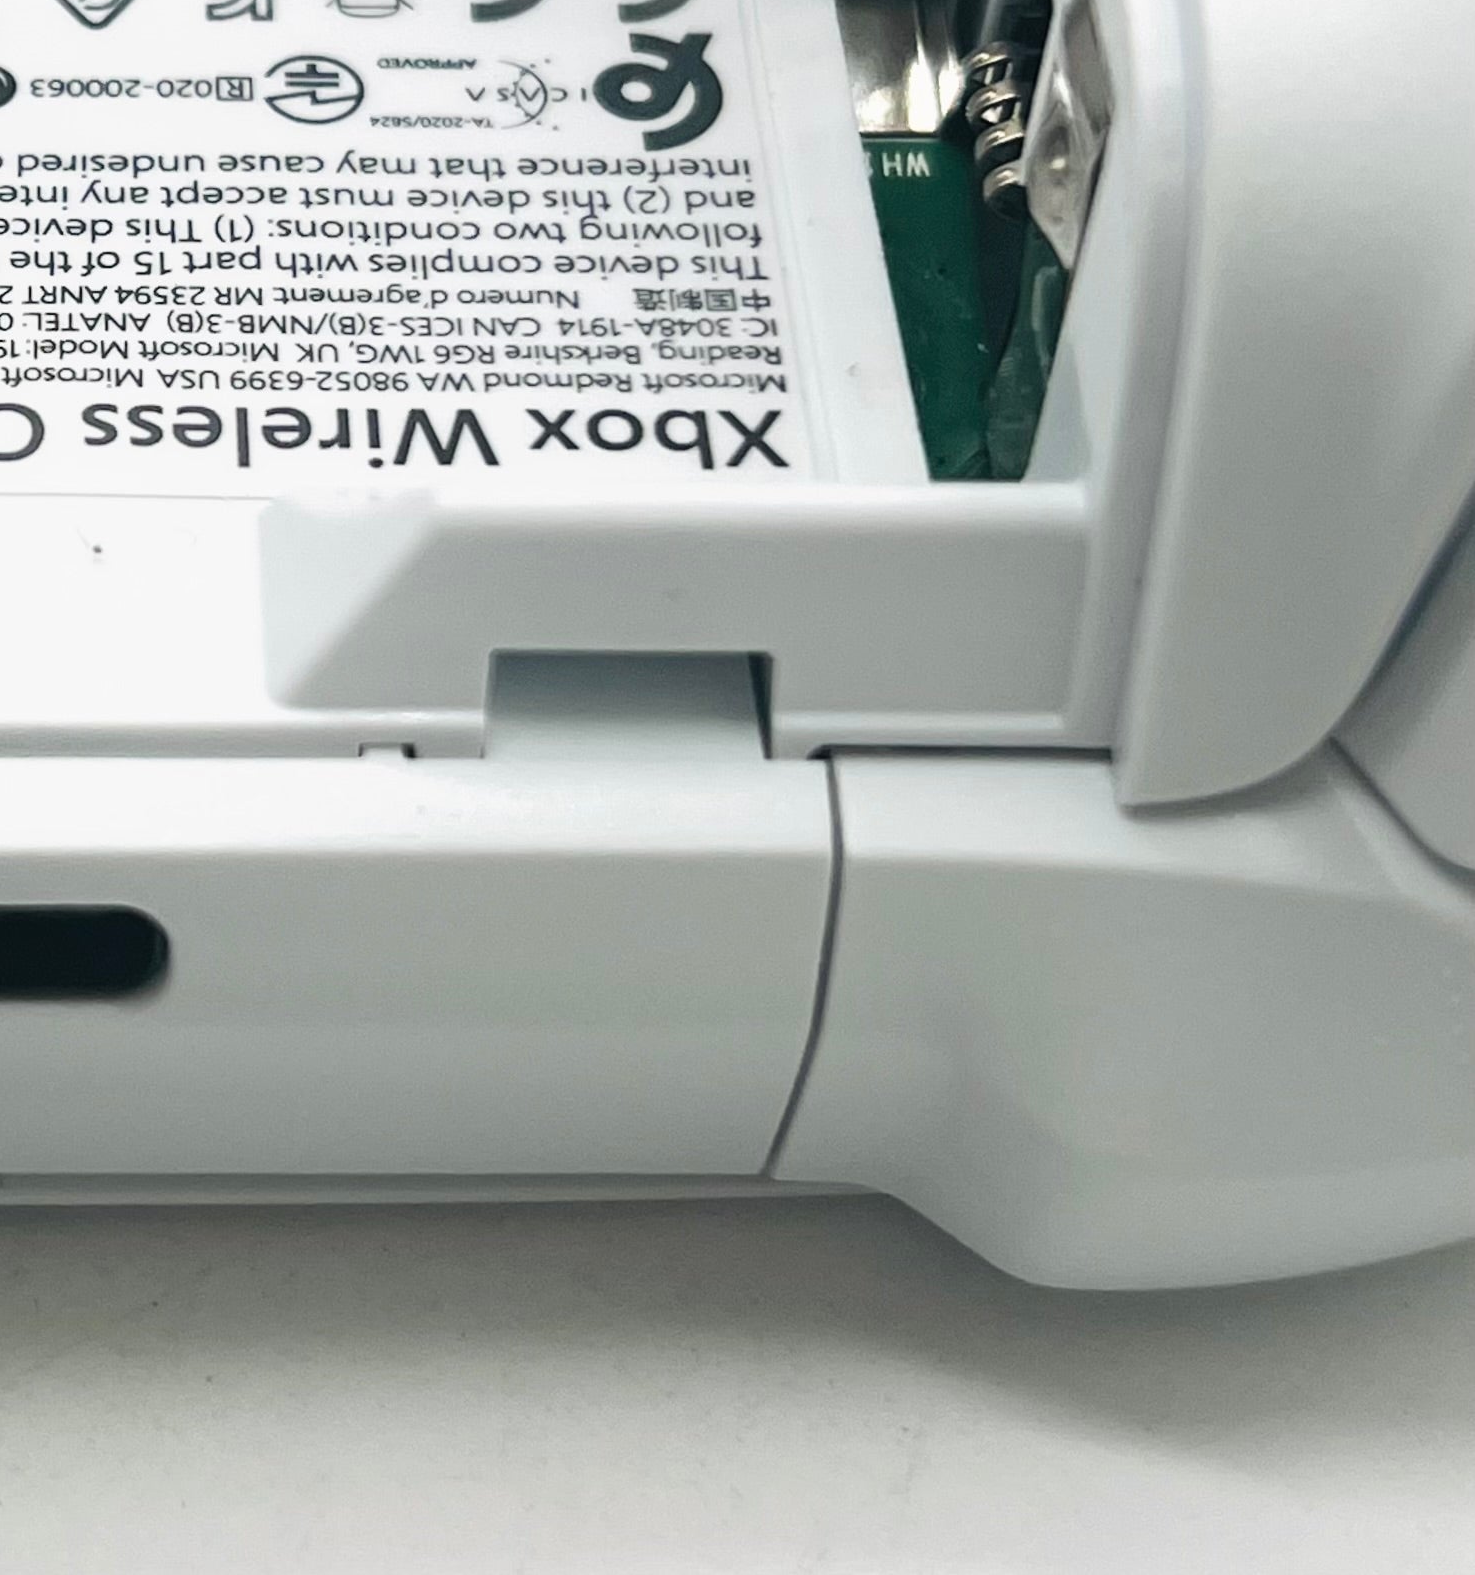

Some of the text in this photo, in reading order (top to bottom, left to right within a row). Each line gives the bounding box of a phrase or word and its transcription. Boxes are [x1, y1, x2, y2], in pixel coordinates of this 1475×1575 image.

[376, 56, 478, 71] APPROVED
[17, 153, 206, 180] undesired
[217, 154, 325, 174] cause
[335, 148, 417, 176] may
[427, 157, 508, 183] that
[516, 157, 753, 184] interference
[881, 151, 931, 178] WH
[80, 179, 150, 205] any
[159, 179, 288, 209] accept
[298, 186, 394, 210] must
[406, 188, 531, 216] device
[541, 189, 613, 218] this
[622, 184, 672, 215] (2)
[683, 189, 757, 216] and
[125, 218, 203, 245] This
[214, 213, 255, 244] (1)
[267, 218, 481, 248] conditions:
[492, 221, 568, 245] two
[578, 212, 764, 250] following
[9, 250, 73, 277] the
[80, 250, 121, 278] of
[133, 250, 173, 276] 15
[181, 244, 262, 274] part
[274, 251, 359, 279] with
[367, 247, 543, 281] complies
[553, 254, 680, 282] device
[690, 254, 771, 282] This
[21, 285, 108, 305] ANRT
[113, 285, 206, 307] 23594
[213, 286, 264, 307] MR
[456, 289, 581, 310] Numero
[631, 287, 772, 314] 中国制造
[22, 311, 152, 333] ANATEL:
[166, 309, 464, 338] ICES-3(B)/NMB-3(B)
[472, 316, 542, 338] CAN
[556, 316, 732, 339] 3048A-1914
[740, 316, 779, 338] IC:
[25, 338, 129, 361] Model:
[137, 339, 280, 363] Microsoft
[294, 342, 340, 364] UK
[348, 340, 425, 365] 1WG,
[432, 344, 496, 365] RG6
[503, 344, 643, 366] Berkshire
[650, 337, 784, 366] Reading,
[0, 366, 144, 389] Microsoft
[156, 368, 221, 391] USA
[229, 369, 410, 393] 98052-6399
[415, 372, 476, 393] WA
[482, 371, 634, 394] Redmond
[640, 372, 789, 395] Microsoft
[81, 402, 501, 470] Wireless
[524, 408, 791, 471] Xbox
